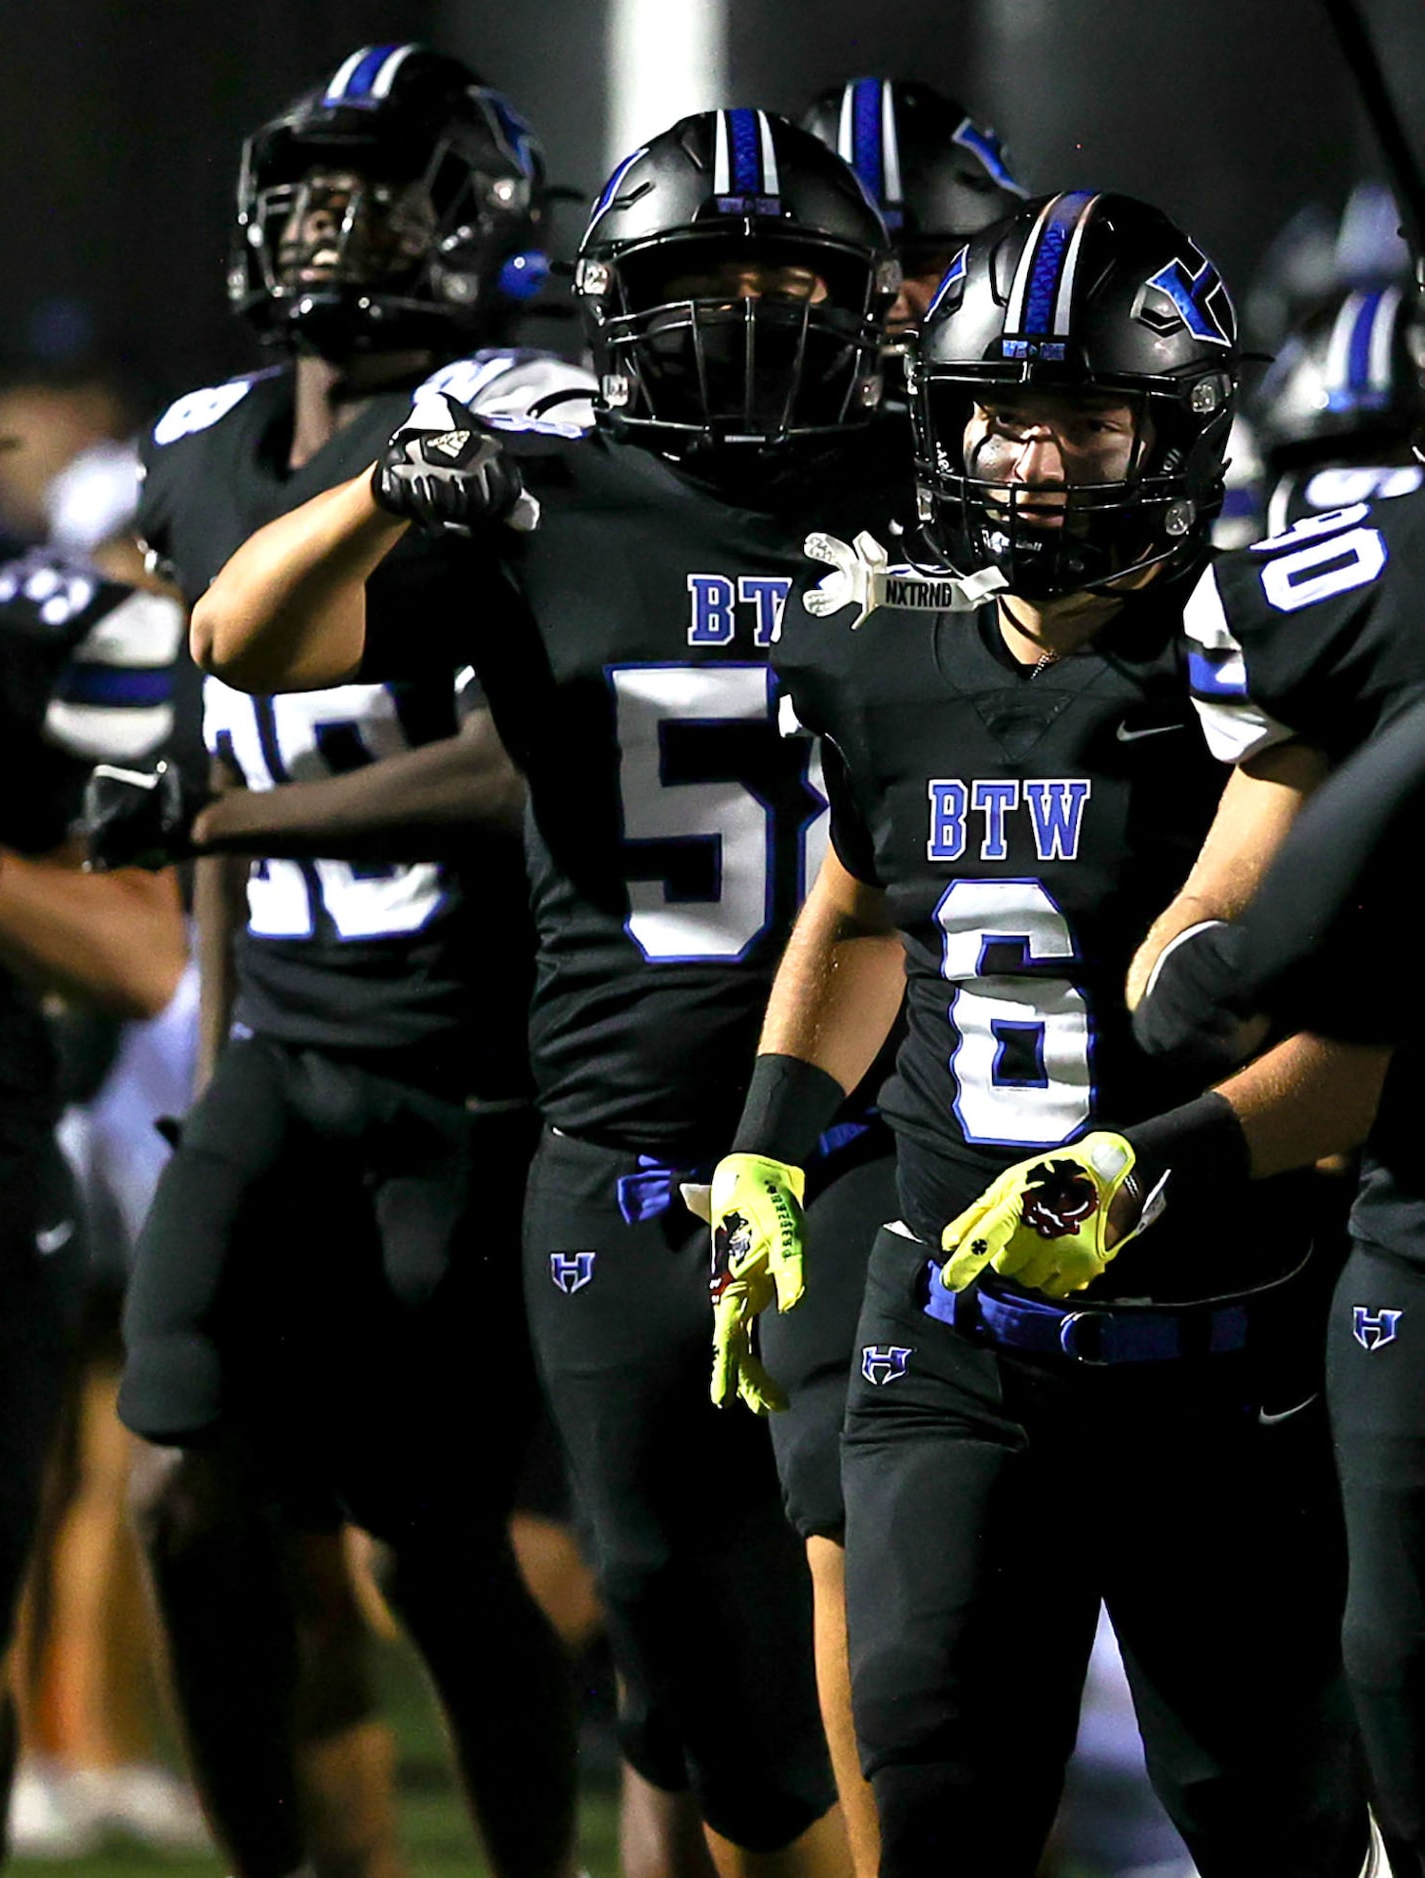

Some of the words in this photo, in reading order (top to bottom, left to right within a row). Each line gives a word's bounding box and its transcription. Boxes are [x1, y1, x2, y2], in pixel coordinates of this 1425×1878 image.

[686, 573, 793, 647] BT
[885, 579, 952, 608] NXTRND
[927, 778, 1092, 861] BTW
[931, 876, 1098, 1149] 6
